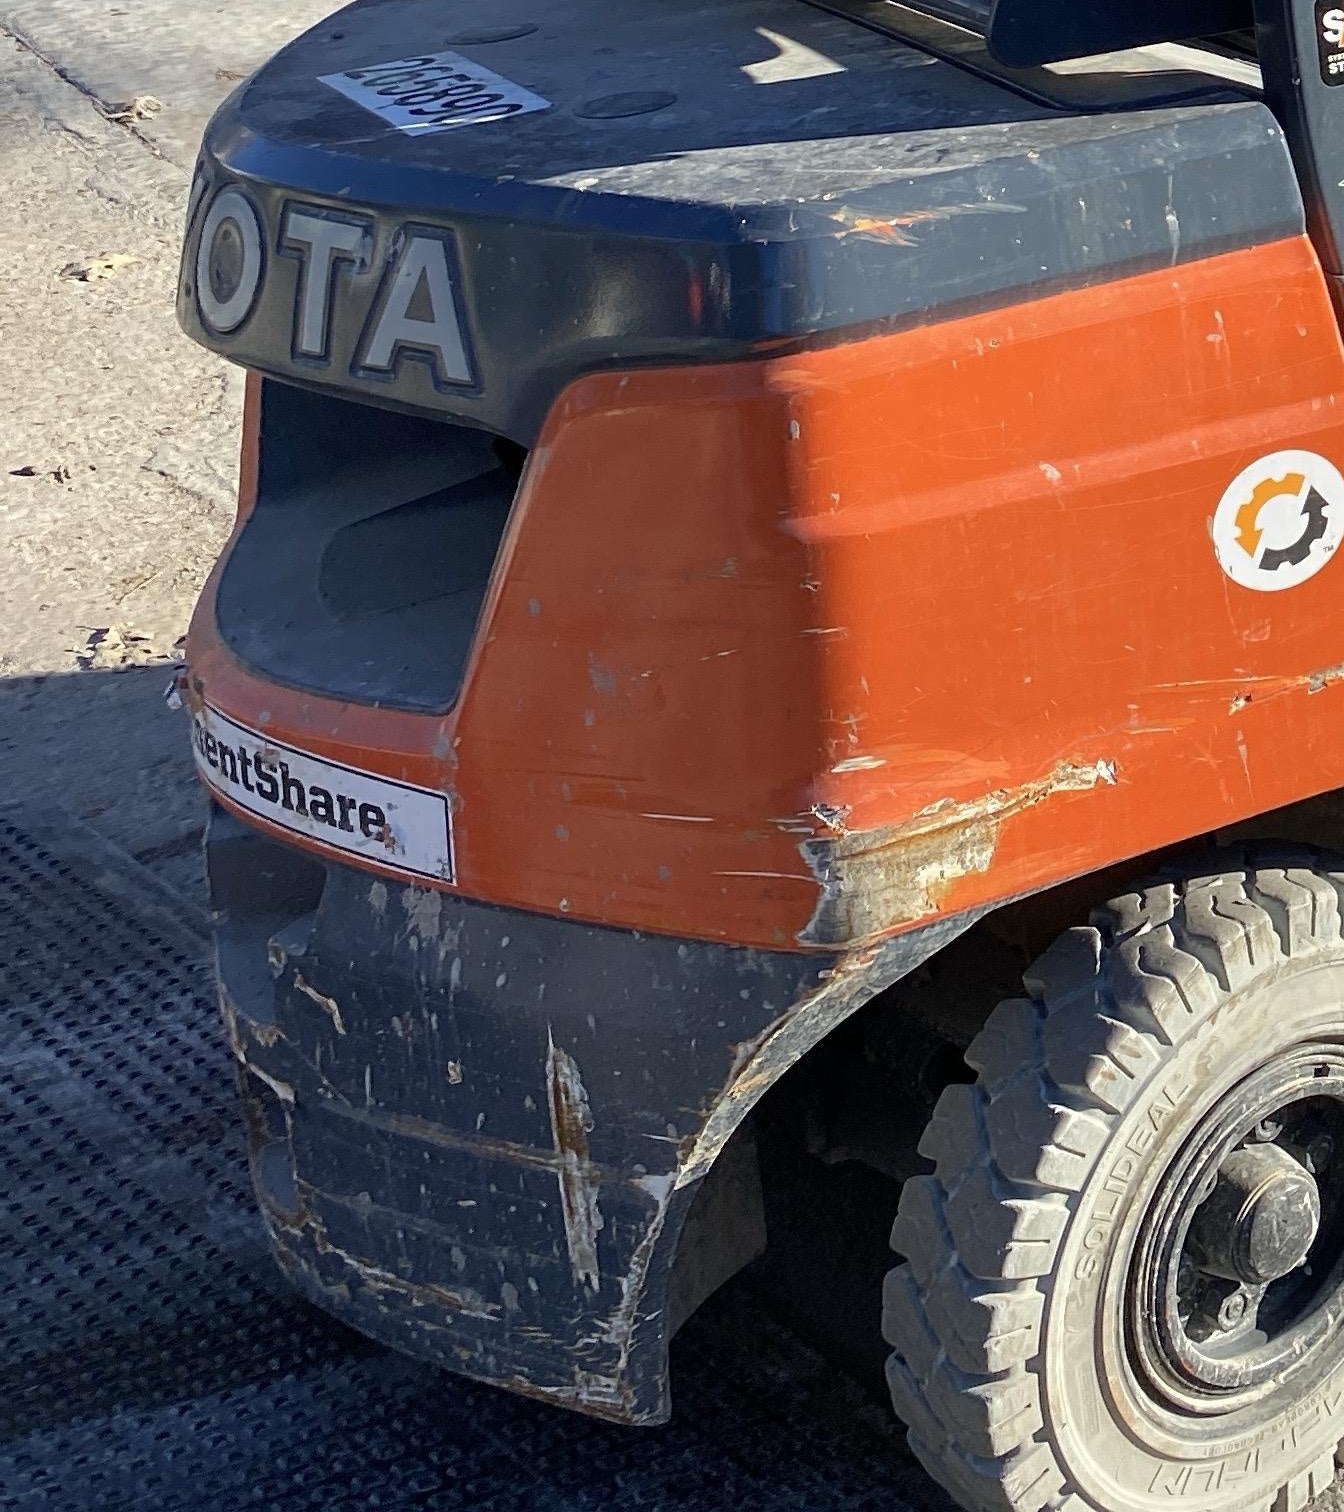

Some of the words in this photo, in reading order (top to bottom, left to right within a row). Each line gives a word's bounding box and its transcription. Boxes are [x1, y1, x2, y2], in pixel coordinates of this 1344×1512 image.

[343, 56, 524, 125] 265890
[188, 178, 474, 385] OTA
[196, 720, 387, 842] entShare
[1074, 1082, 1192, 1281] SOLIDEAL
